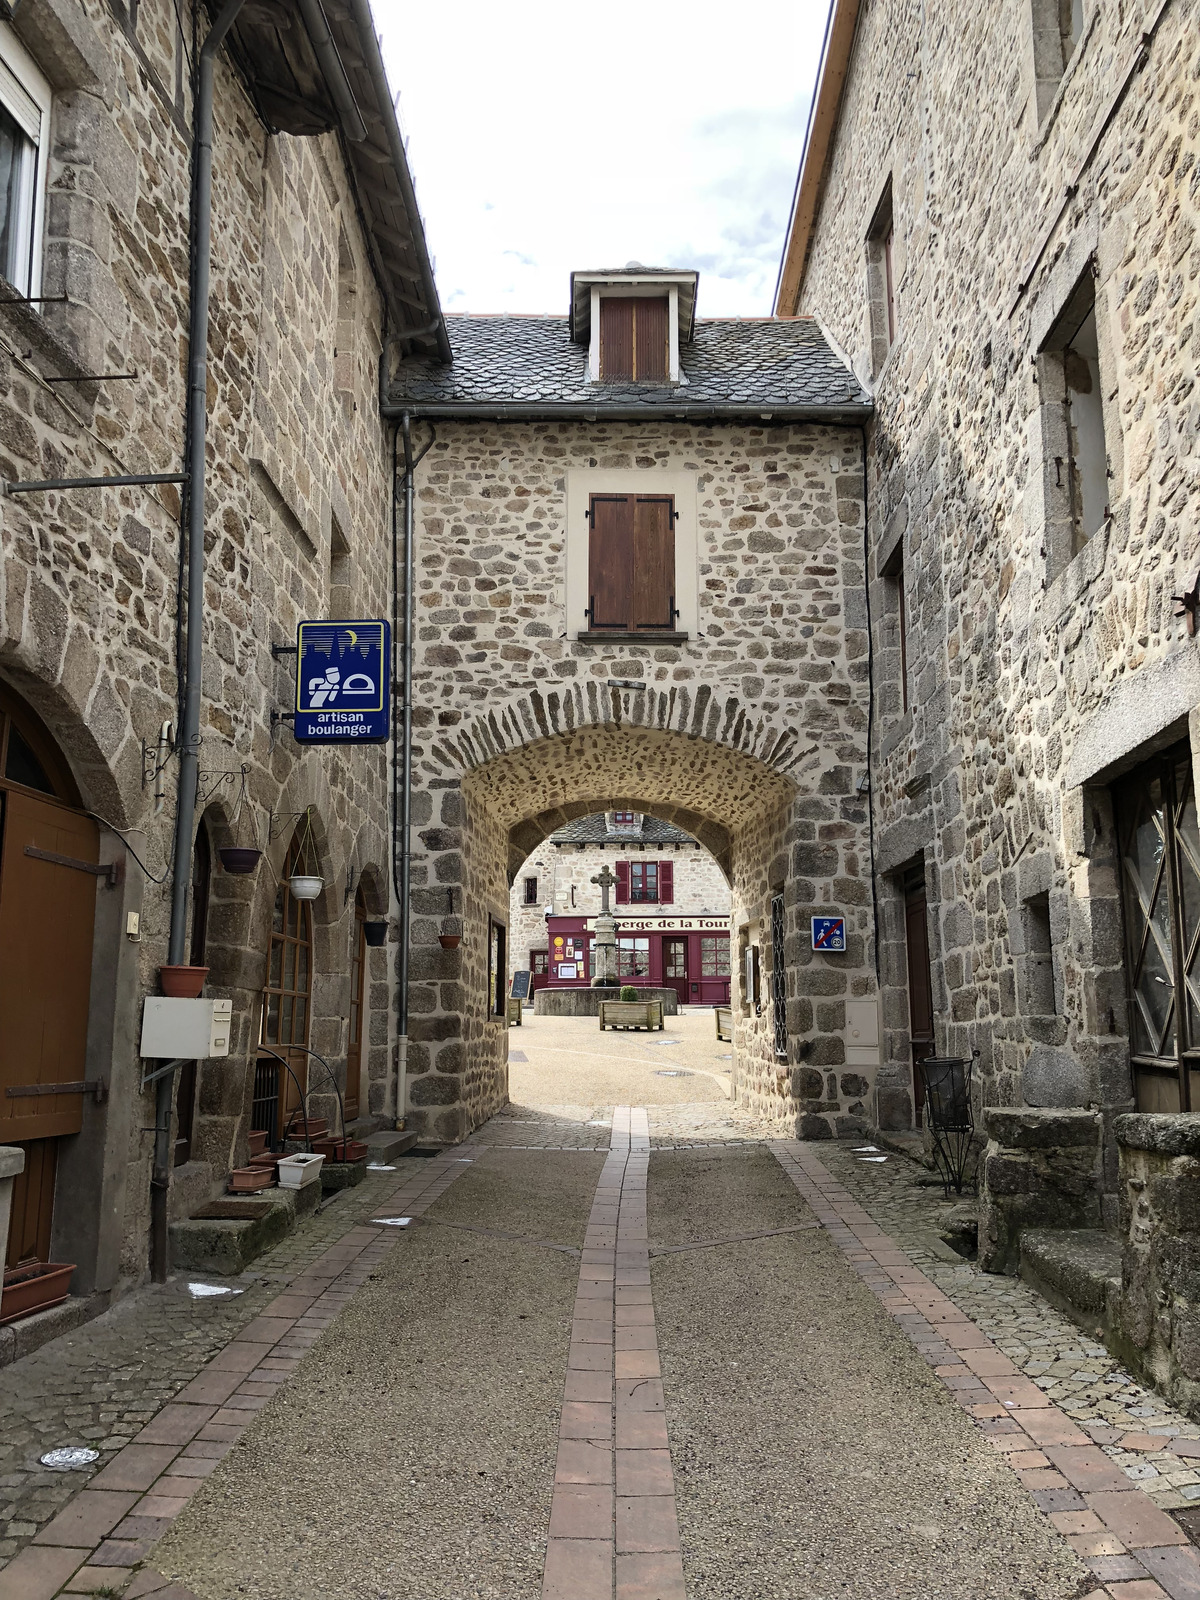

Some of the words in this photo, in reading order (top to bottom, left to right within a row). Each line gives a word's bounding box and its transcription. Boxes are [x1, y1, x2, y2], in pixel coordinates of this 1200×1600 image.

[317, 712, 364, 722] artisan
[308, 724, 372, 736] boulanger
[657, 919, 674, 928] de
[680, 919, 692, 928] la
[697, 919, 730, 928] Tour
